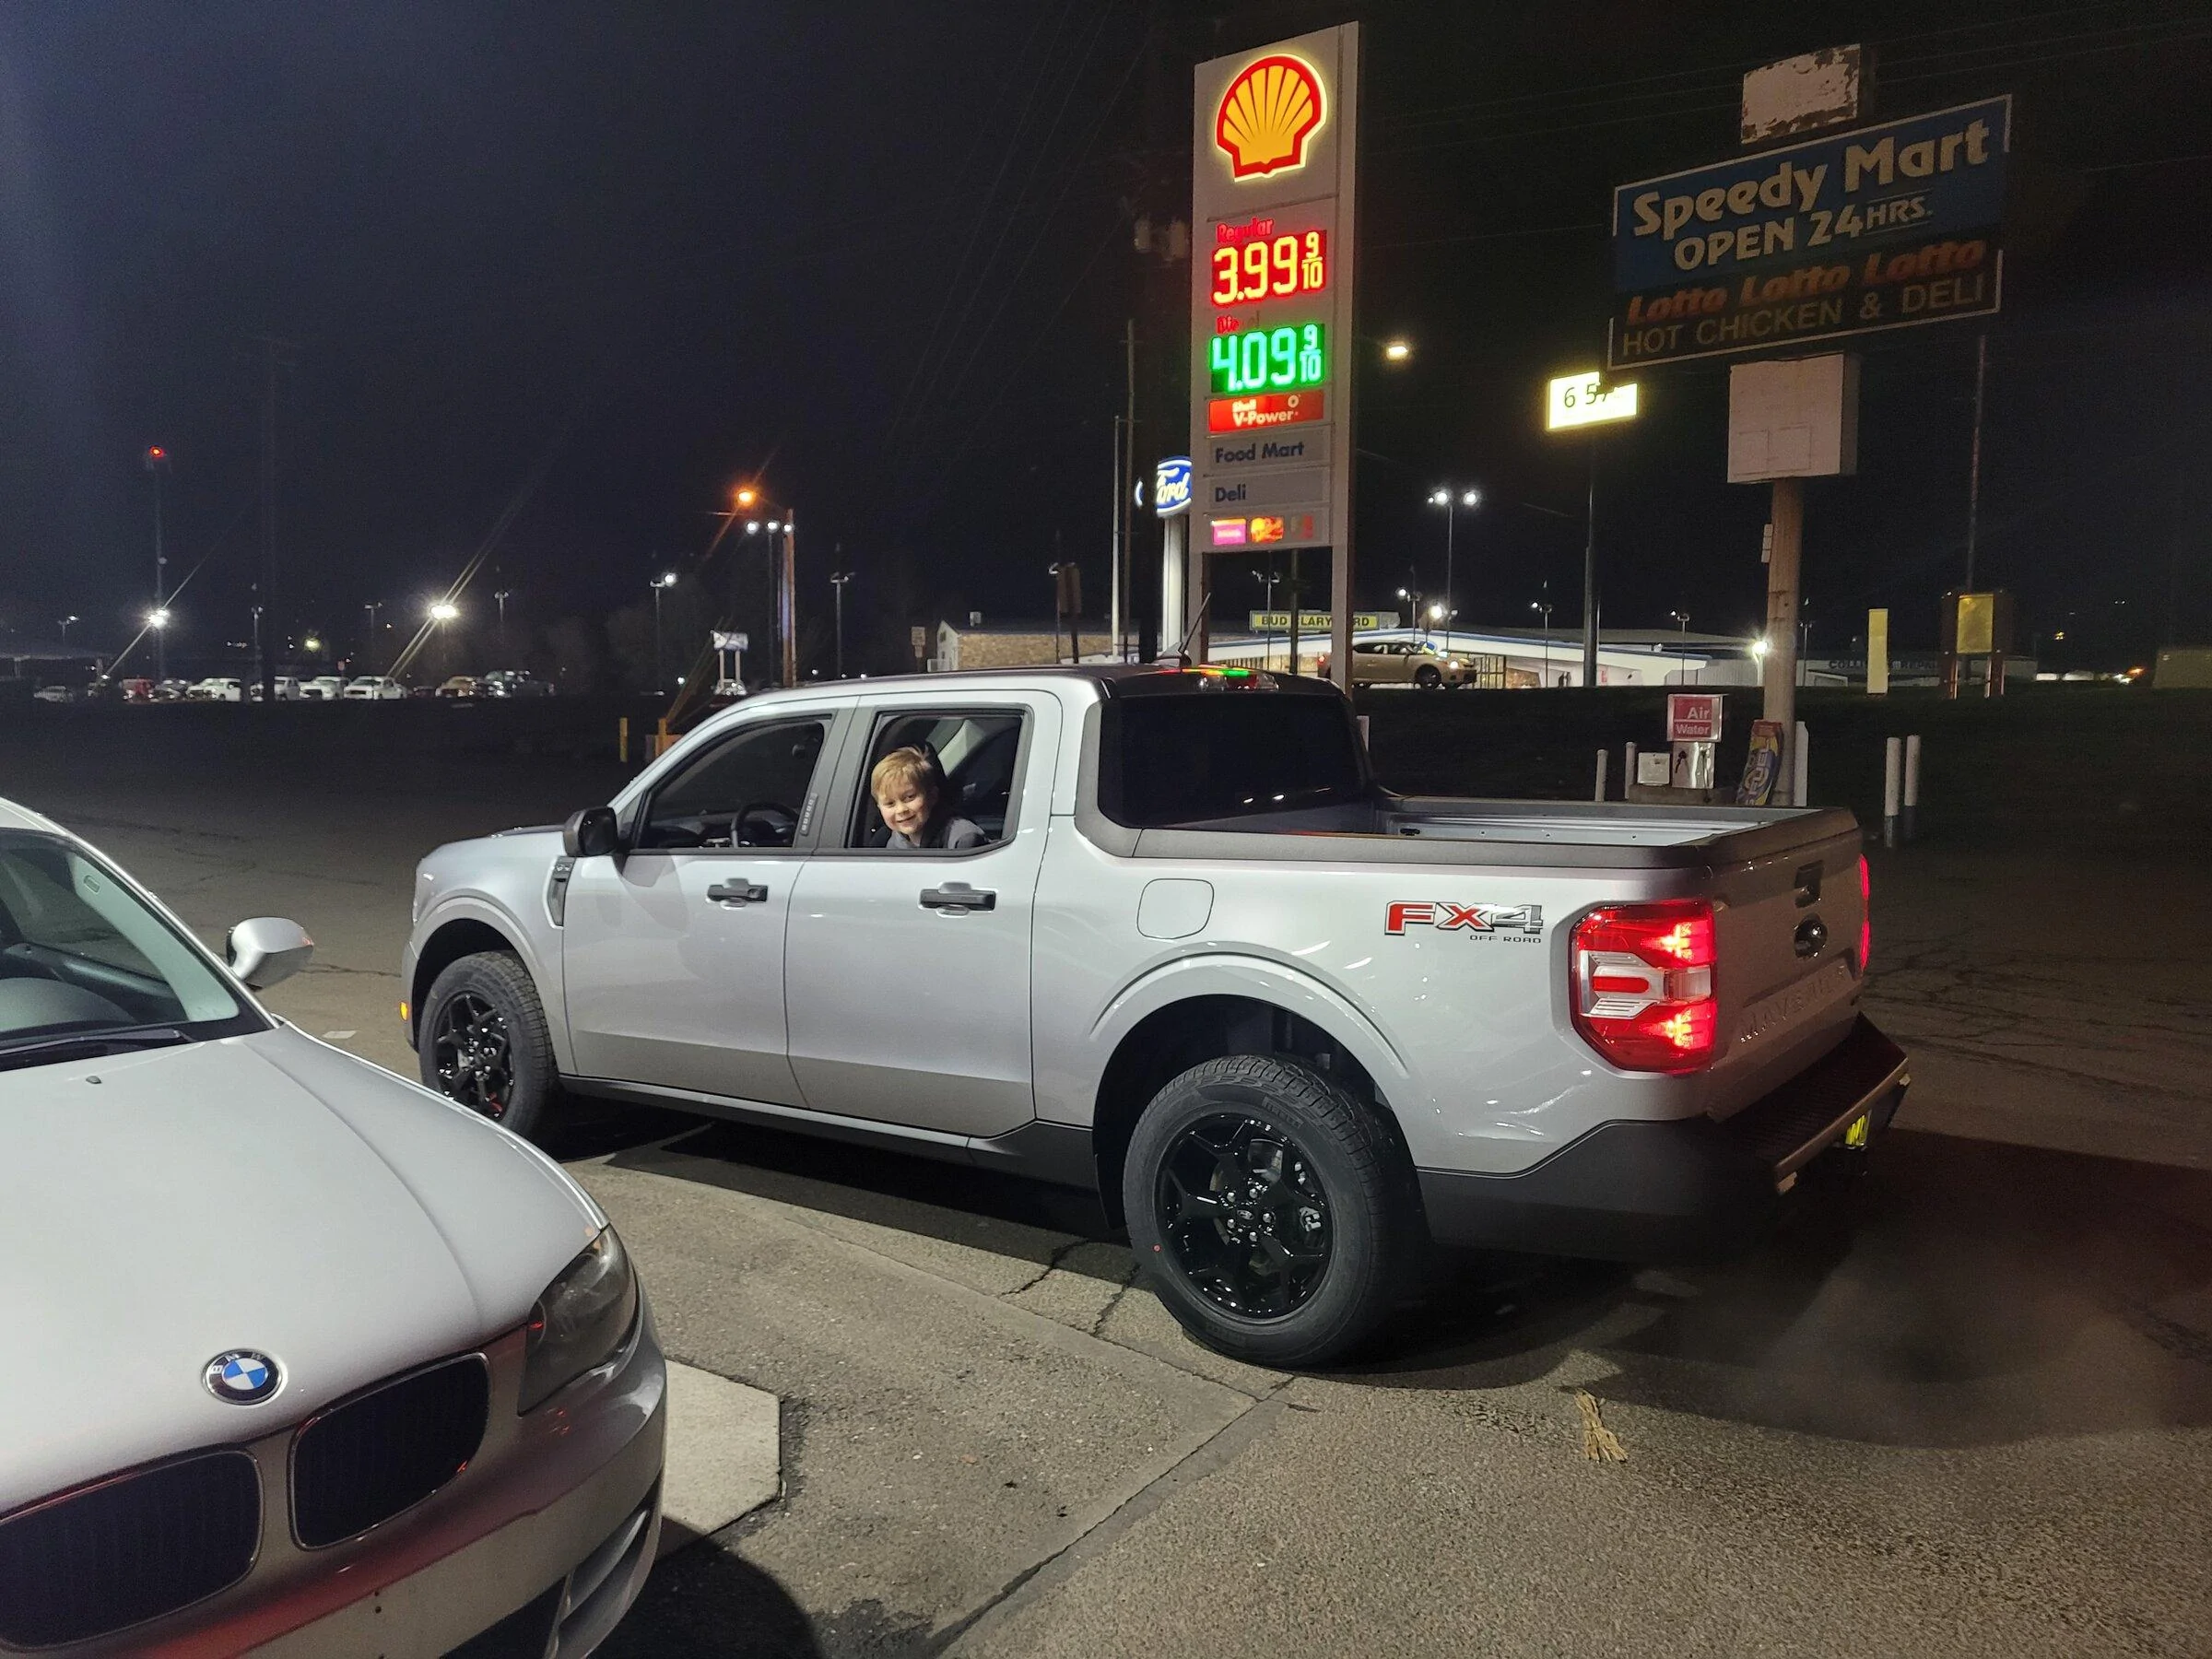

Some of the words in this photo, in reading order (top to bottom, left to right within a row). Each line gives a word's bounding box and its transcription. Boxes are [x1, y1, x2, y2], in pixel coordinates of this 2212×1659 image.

[1633, 161, 1829, 241] Speedy
[1845, 119, 1990, 193] Mart
[1218, 218, 1274, 243] Regular
[1674, 217, 1795, 271] OPEN
[1807, 205, 1864, 247] 24
[1213, 235, 1298, 304] 3.99
[1627, 287, 1729, 325] Lotto
[1740, 265, 1852, 307] Lotto
[1863, 240, 1986, 285] Lotto
[1623, 325, 1683, 356] HOT
[1696, 297, 1842, 345] CHICKEN
[1859, 291, 1882, 320] &
[1902, 273, 1983, 314] DELI
[1212, 326, 1297, 392] 4.09
[1232, 409, 1295, 427] V-Power
[1215, 443, 1255, 463] Food
[1262, 441, 1305, 459] Mart
[1156, 466, 1192, 504] Ford
[1215, 484, 1247, 502] Deli
[1261, 616, 1288, 626] BUD
[1299, 616, 1333, 627] LARY
[1687, 706, 1712, 720] Air
[1676, 724, 1712, 735] Water
[1384, 900, 1544, 936] FX4
[1469, 934, 1499, 942] OFF
[1502, 935, 1543, 945] ROAD
[209, 1352, 265, 1374] BMW
